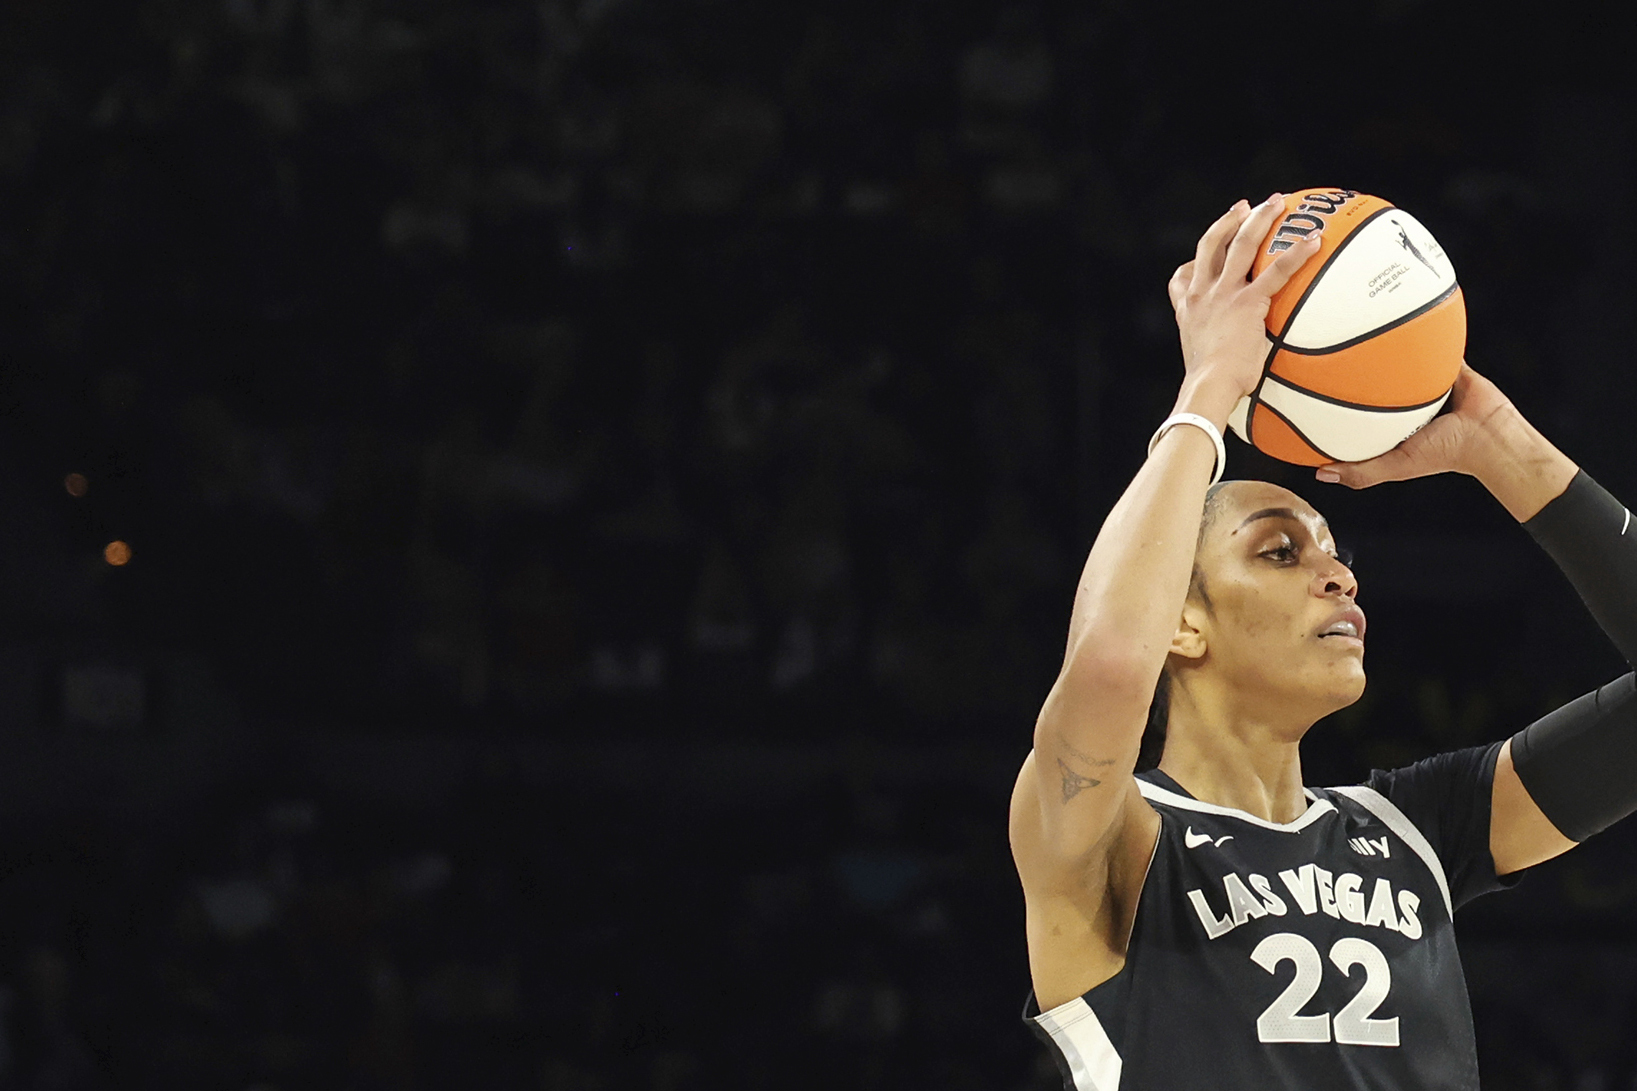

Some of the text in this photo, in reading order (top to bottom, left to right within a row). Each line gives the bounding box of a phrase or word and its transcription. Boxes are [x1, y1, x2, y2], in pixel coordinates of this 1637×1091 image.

[1368, 262, 1402, 288] OFFICIAL
[1368, 278, 1393, 298] GAME
[1391, 266, 1411, 282] BALL
[1187, 863, 1423, 940] LAS VEGAS
[1250, 932, 1400, 1047] 22
